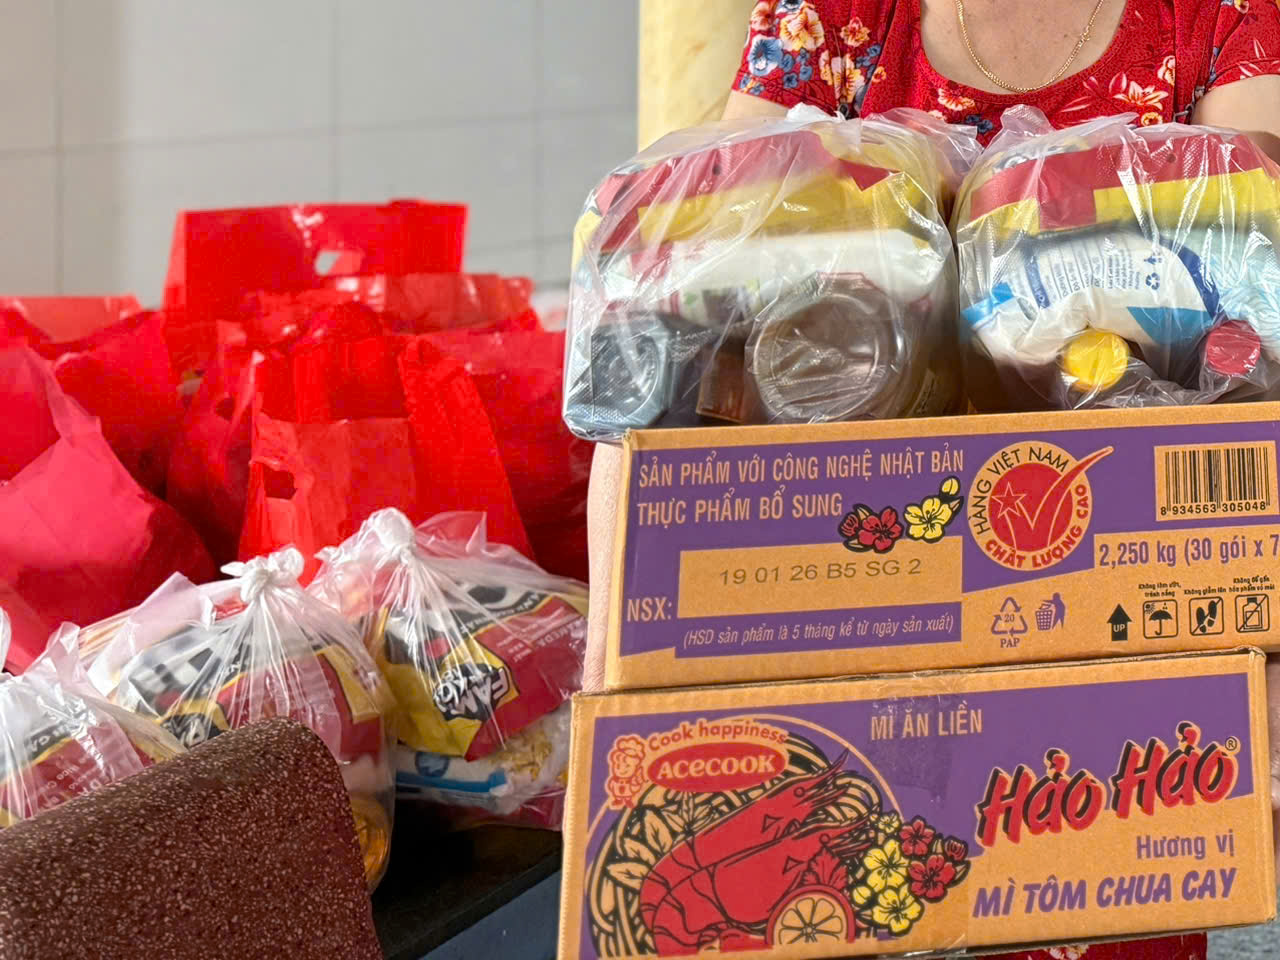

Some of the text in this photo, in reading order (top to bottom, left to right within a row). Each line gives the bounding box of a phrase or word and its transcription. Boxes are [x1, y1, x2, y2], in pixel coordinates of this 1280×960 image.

[639, 442, 964, 488] SẢN PHẨM VỚI CÔNG NGHỆ NHẬT BẢN
[636, 484, 843, 529] THỰC PHẨM BỔ SUNG
[968, 446, 1069, 535] HÀNG VIỆT NAM
[984, 483, 1089, 569] CHẤT LƯỢNG CAO
[1161, 502, 1266, 516] 8 934563 305048
[1099, 540, 1149, 570] 2,250
[1156, 542, 1177, 567] kg
[1184, 537, 1212, 566] (30
[1219, 535, 1247, 563] gói
[1254, 540, 1264, 557] x
[719, 558, 921, 586] 19 01 26 B5 SG 2
[626, 596, 672, 622] NSX:
[1004, 614, 1015, 623] 20
[683, 612, 955, 649] (HSD sản phẩm là 5 tháng kể từ ngày sản xuất)
[1000, 638, 1020, 649] PAP
[1113, 624, 1125, 633] UP
[649, 720, 787, 752] Cook happiness
[902, 707, 929, 738] ĂN
[938, 701, 982, 737] LIỀN
[976, 721, 1236, 847] Hảo Hảo
[1136, 830, 1235, 860] Hương vị
[973, 867, 1237, 918] MÌ TÔM CHUA CAY
